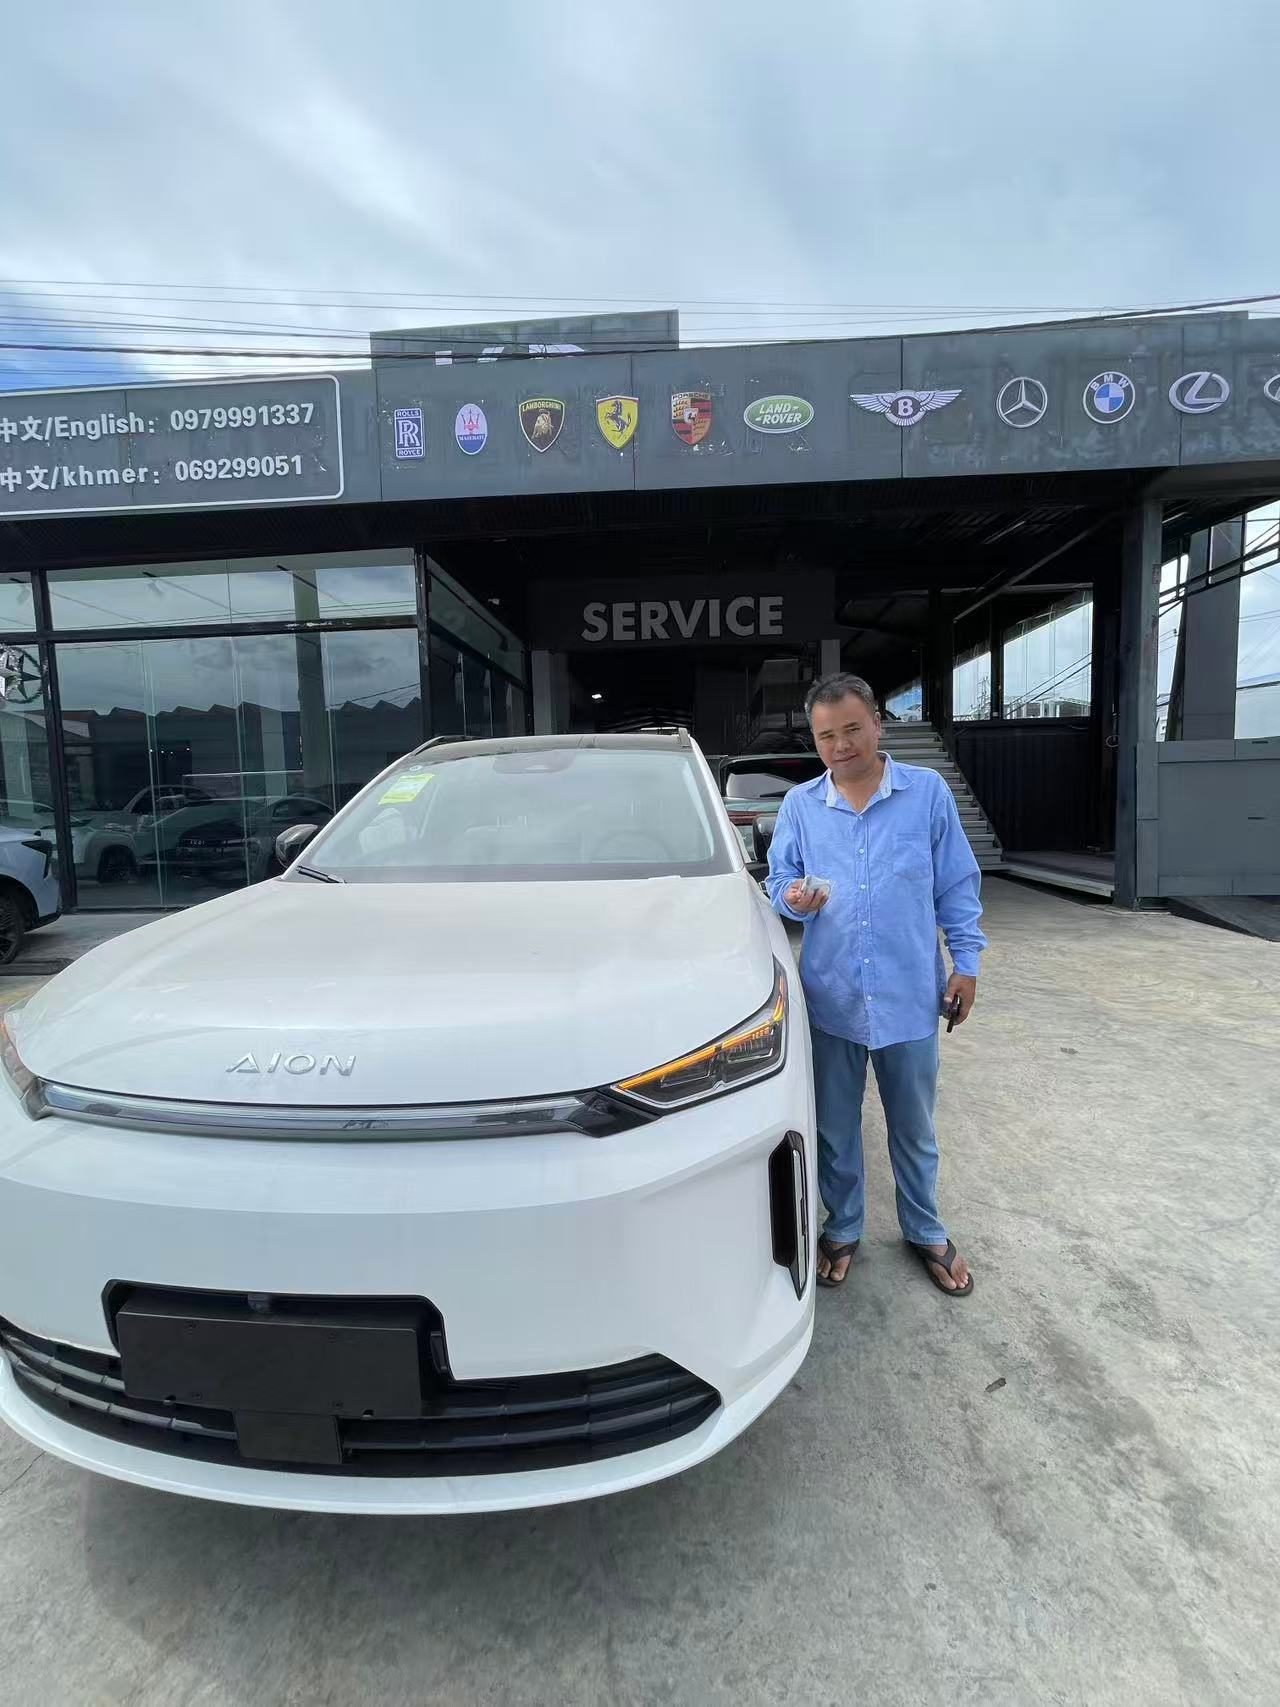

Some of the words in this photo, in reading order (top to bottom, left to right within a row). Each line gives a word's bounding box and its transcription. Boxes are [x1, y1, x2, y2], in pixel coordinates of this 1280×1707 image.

[1090, 374, 1129, 391] BMW
[170, 403, 314, 431] 0979991337
[760, 403, 792, 414] LAND
[762, 413, 802, 425] ROVER
[175, 455, 303, 481] 069299051
[581, 596, 784, 642] SERVICE
[225, 1051, 357, 1077] AION
